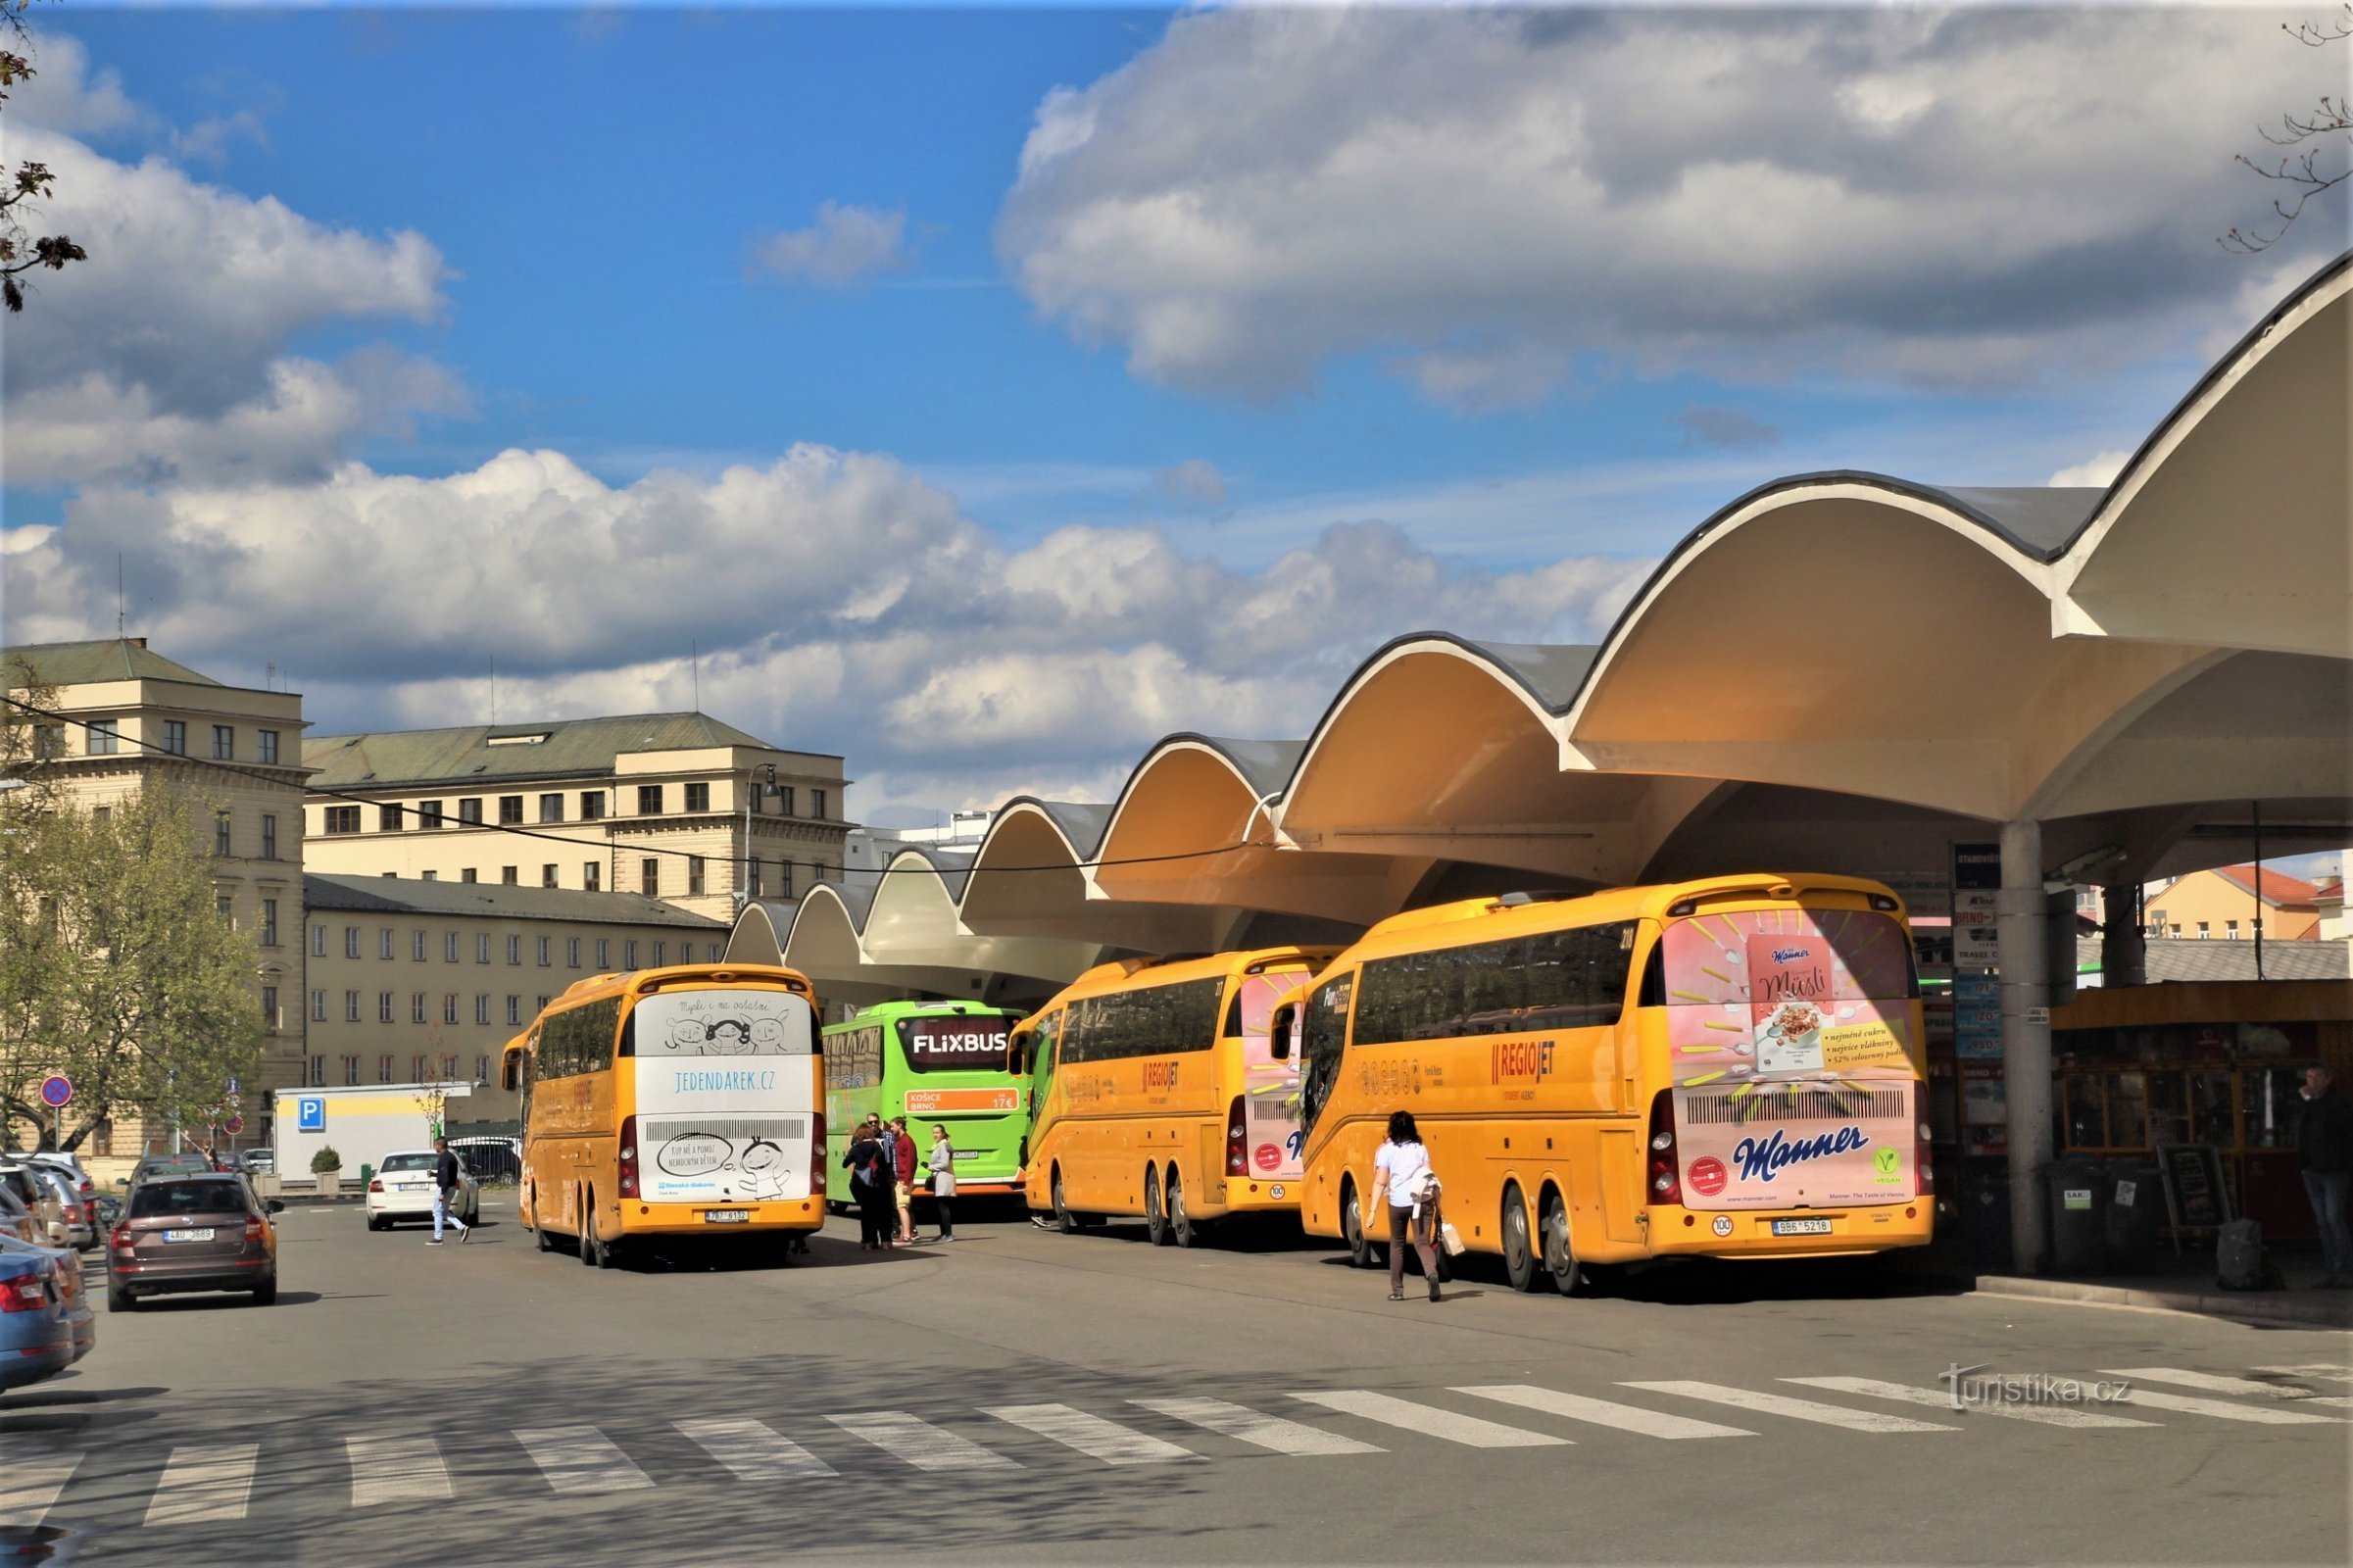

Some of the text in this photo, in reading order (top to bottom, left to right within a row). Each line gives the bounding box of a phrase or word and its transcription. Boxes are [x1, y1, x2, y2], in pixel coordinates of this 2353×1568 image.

[1620, 927, 1634, 949] 218
[1772, 949, 1810, 963] Manner
[1760, 966, 1826, 1001] Müsli
[679, 1000, 705, 1014] Mysli
[718, 1002, 729, 1010] na
[1864, 1027, 1887, 1037] cukru
[675, 1070, 775, 1094] JEDENDAREK.CZ
[910, 1092, 941, 1102] KOŠICE
[304, 1102, 318, 1120] P
[1733, 1126, 1870, 1181] Manner
[1715, 1218, 1731, 1230] 100
[1804, 1220, 1827, 1231] 5218
